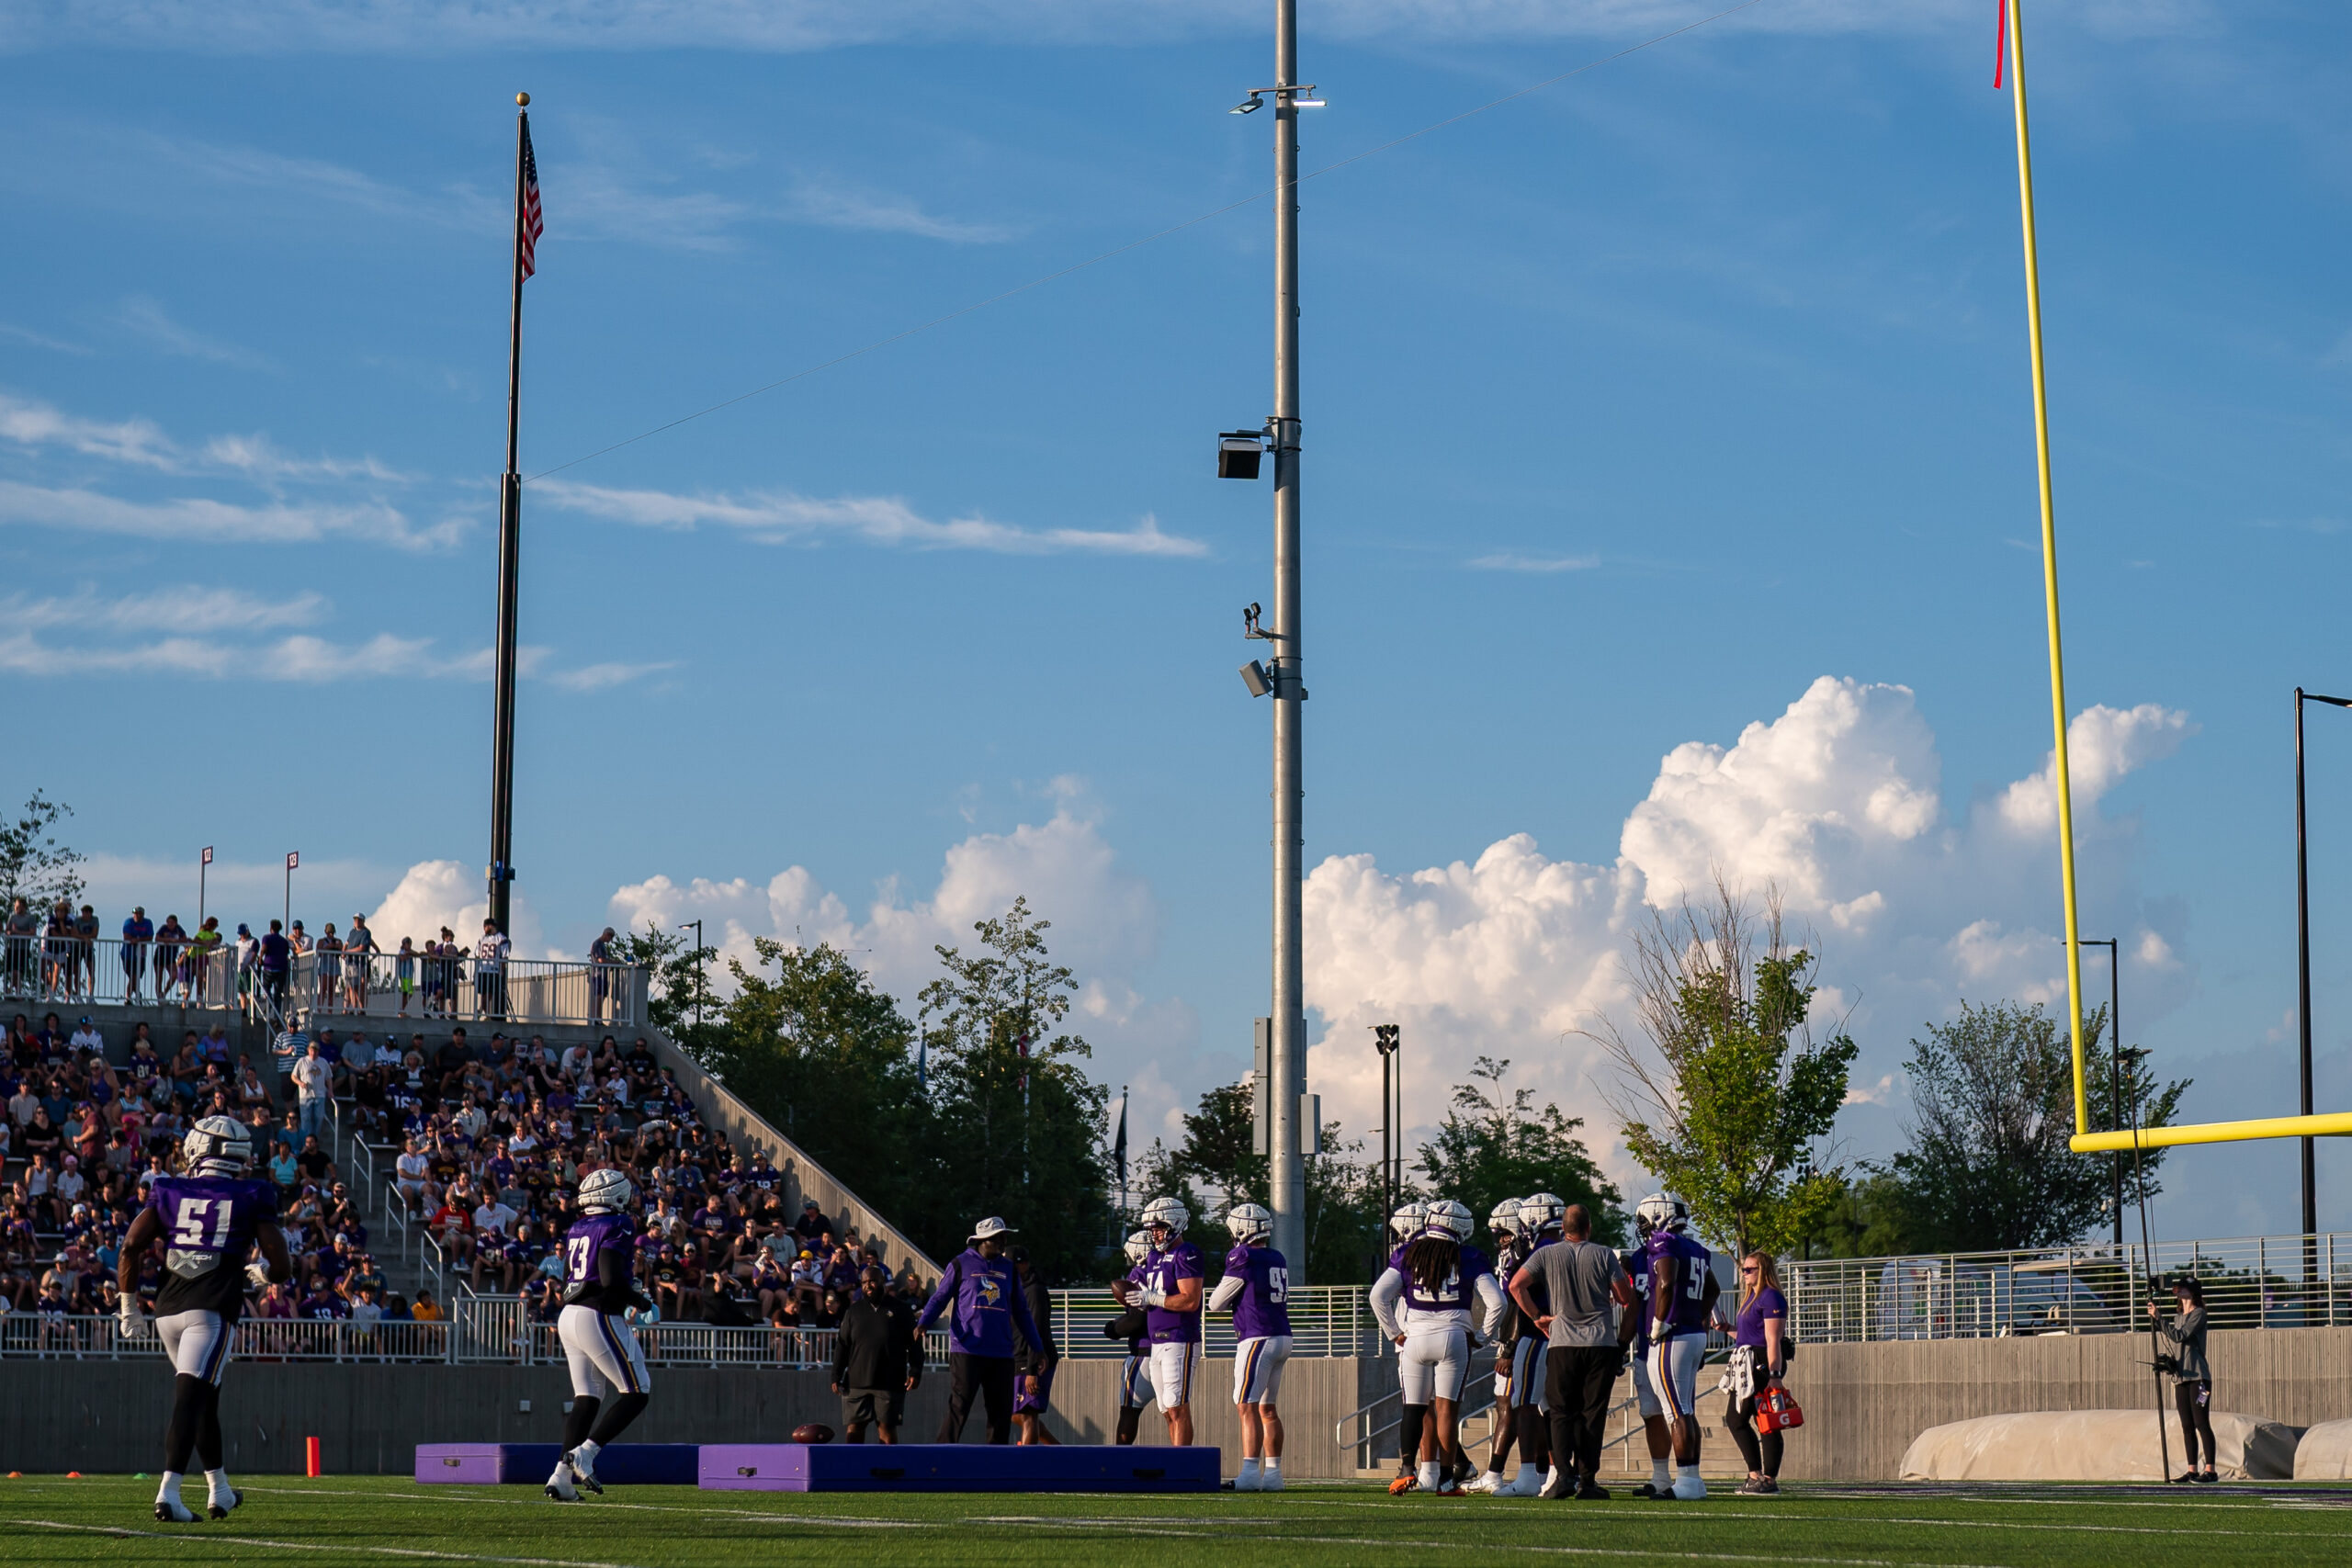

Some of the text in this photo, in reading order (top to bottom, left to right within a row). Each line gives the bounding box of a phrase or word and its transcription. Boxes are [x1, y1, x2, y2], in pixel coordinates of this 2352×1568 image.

[175, 1198, 233, 1247] 51
[568, 1235, 591, 1280] 73
[1779, 1413, 1791, 1426] G
